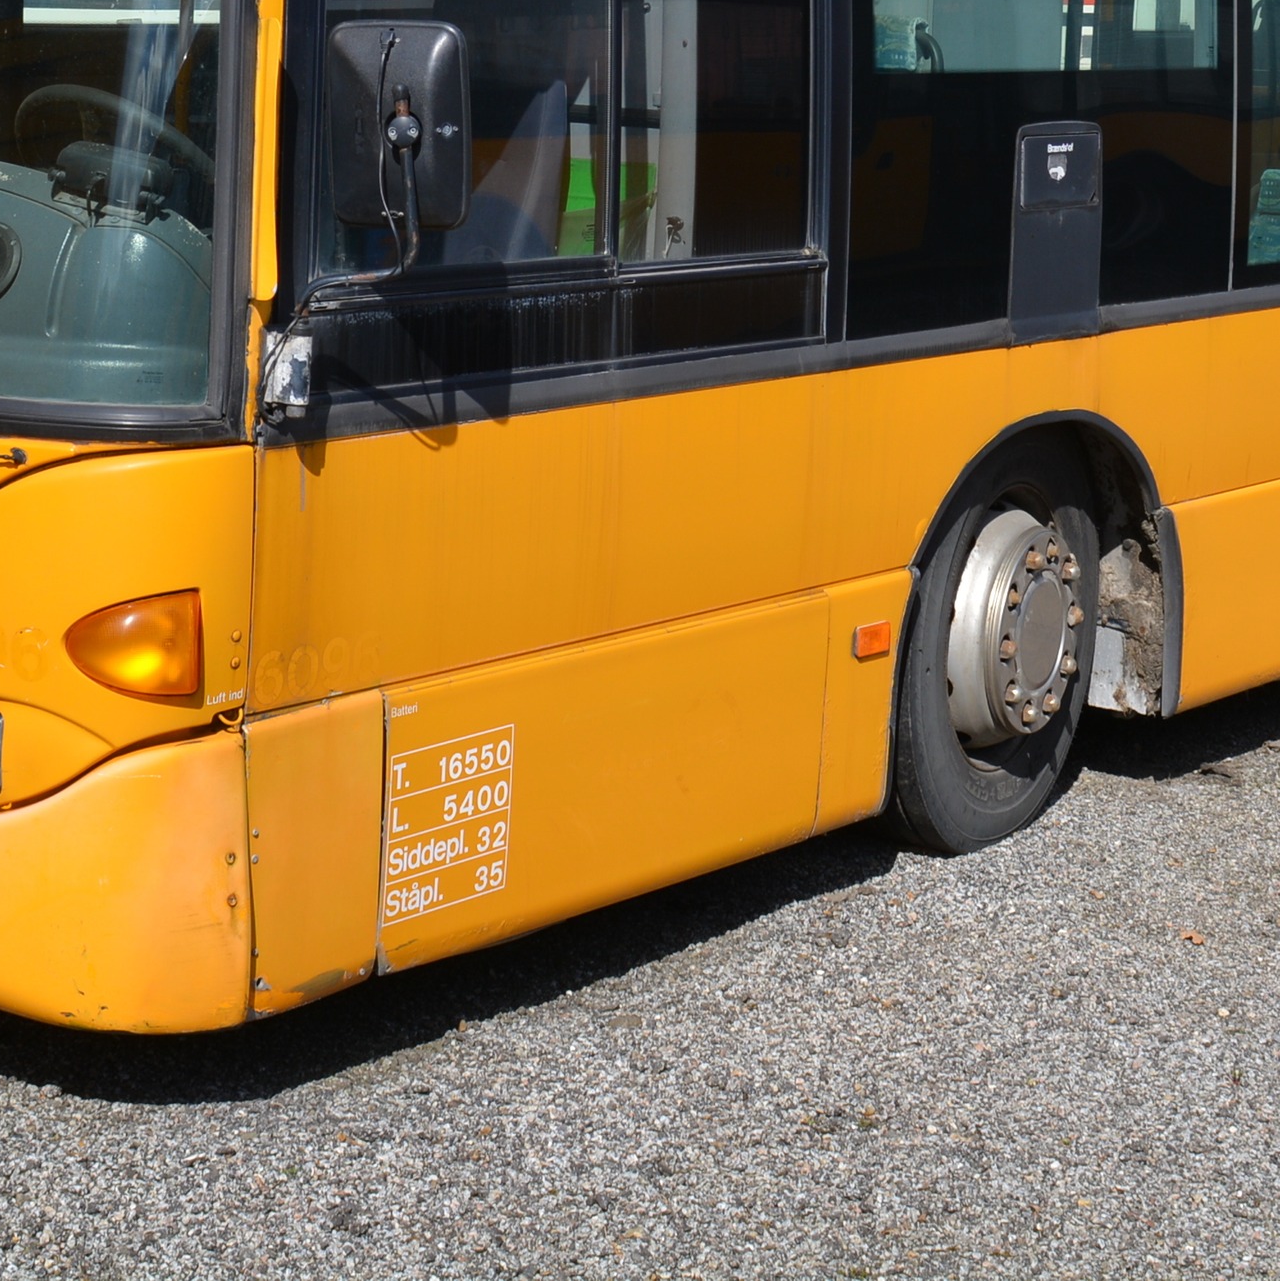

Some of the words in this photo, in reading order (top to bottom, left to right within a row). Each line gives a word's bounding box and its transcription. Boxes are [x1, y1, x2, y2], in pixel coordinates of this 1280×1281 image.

[206, 692, 227, 706] Luft
[229, 688, 244, 701] ind
[391, 702, 418, 718] Batteri
[393, 762, 410, 790] T.
[439, 739, 511, 783] 16550
[392, 807, 409, 833] L.
[443, 780, 509, 822] 5400
[388, 829, 469, 876] Siddepl.
[477, 821, 506, 853] 32
[385, 877, 444, 918] Ståpl.
[474, 860, 504, 891] 35
